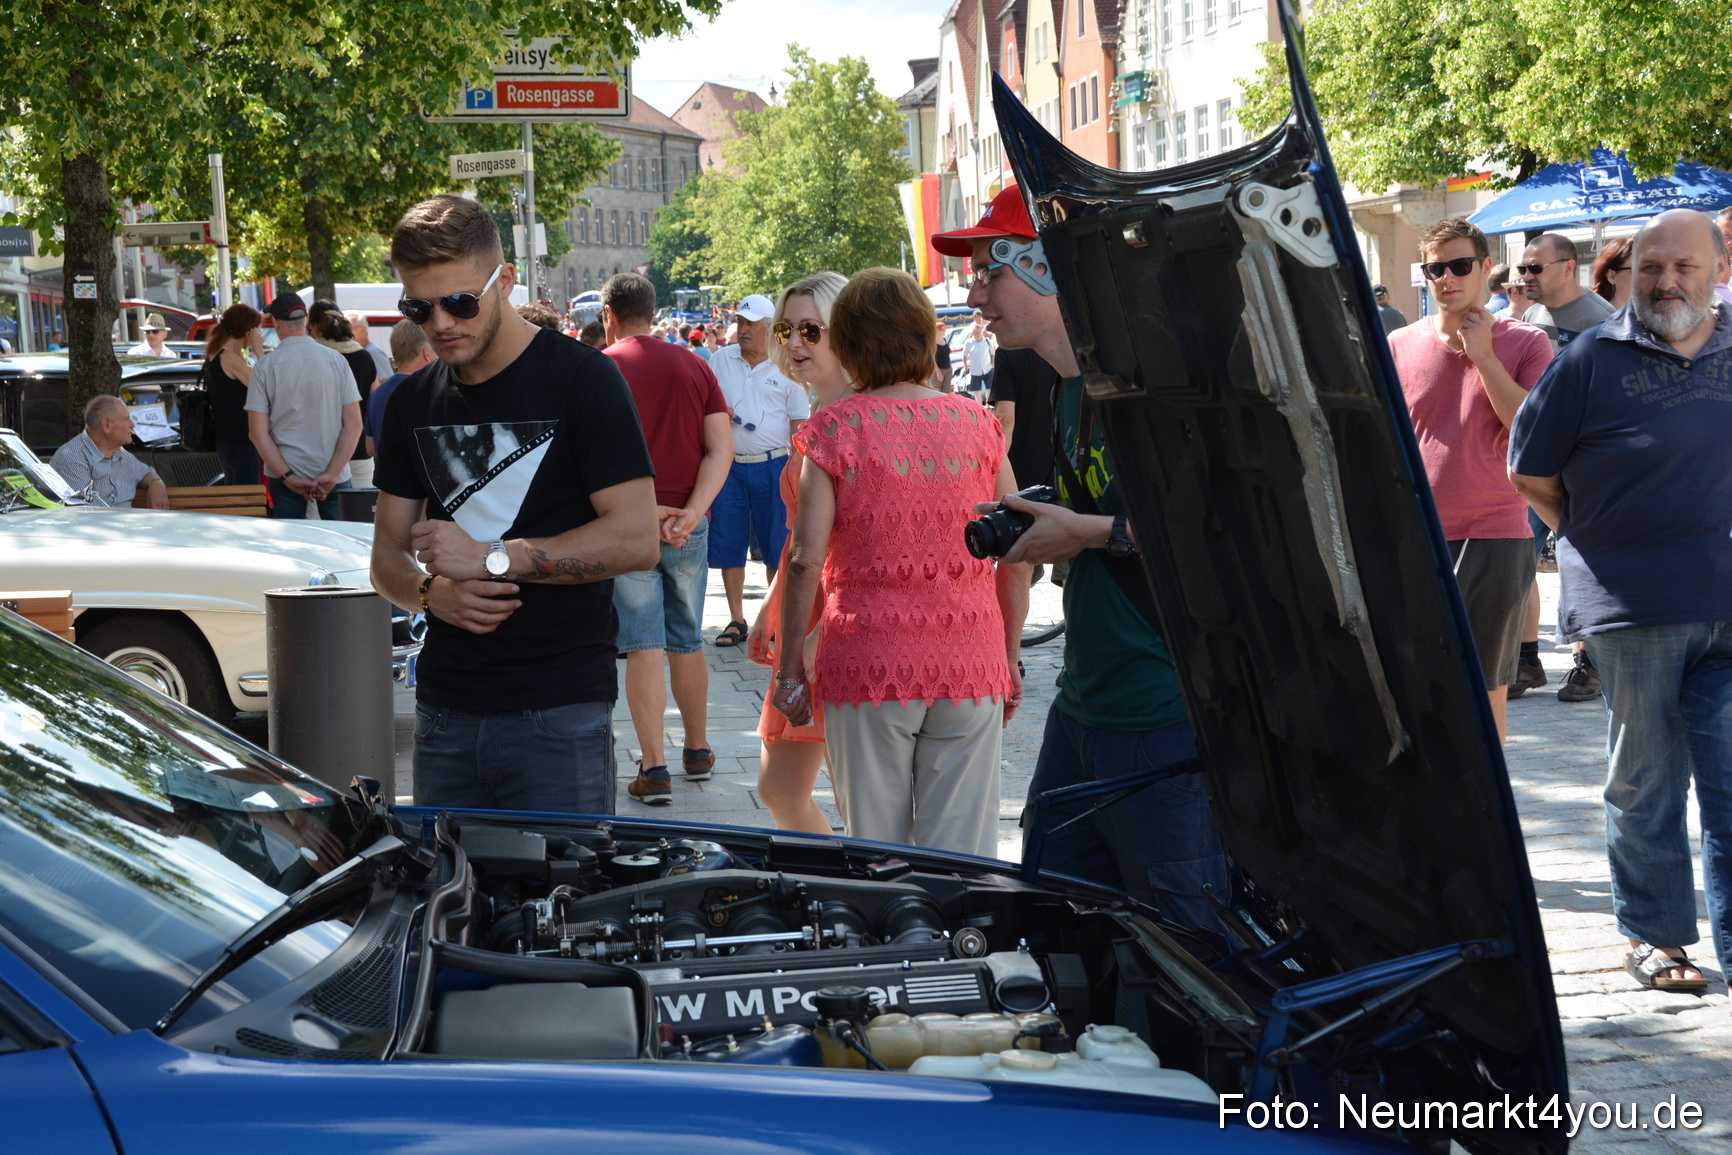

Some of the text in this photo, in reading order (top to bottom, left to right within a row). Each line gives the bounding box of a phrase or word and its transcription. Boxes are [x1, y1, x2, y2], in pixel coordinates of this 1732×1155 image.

[506, 85, 595, 106] Rosengasse
[457, 156, 516, 174] Rosengasse
[0, 237, 28, 248] ONITA
